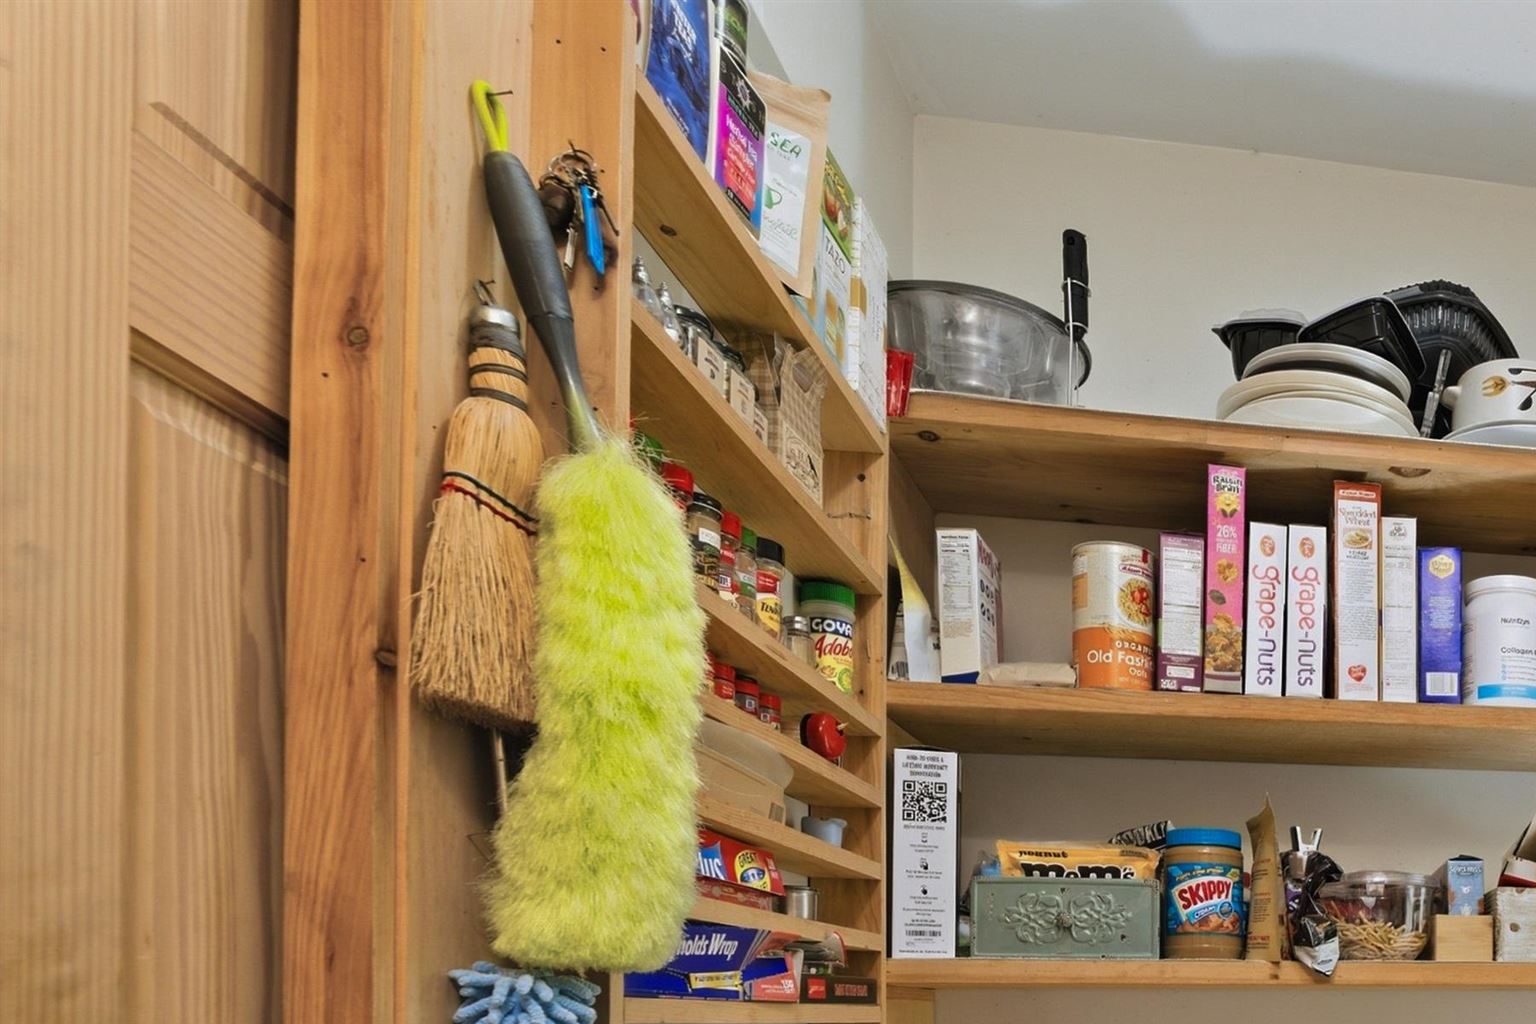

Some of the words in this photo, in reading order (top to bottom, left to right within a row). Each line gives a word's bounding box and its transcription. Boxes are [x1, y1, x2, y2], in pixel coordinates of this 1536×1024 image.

[769, 131, 803, 159] SEA
[824, 235, 847, 275] TAZO
[1216, 525, 1238, 538] 26%
[1252, 565, 1281, 688] grape-nuts
[1291, 566, 1320, 688] grape-nuts
[1087, 650, 1112, 665] Old
[1500, 646, 1533, 656] Collagen
[1178, 880, 1232, 911] SKIPPY
[708, 933, 739, 961] Wrap
